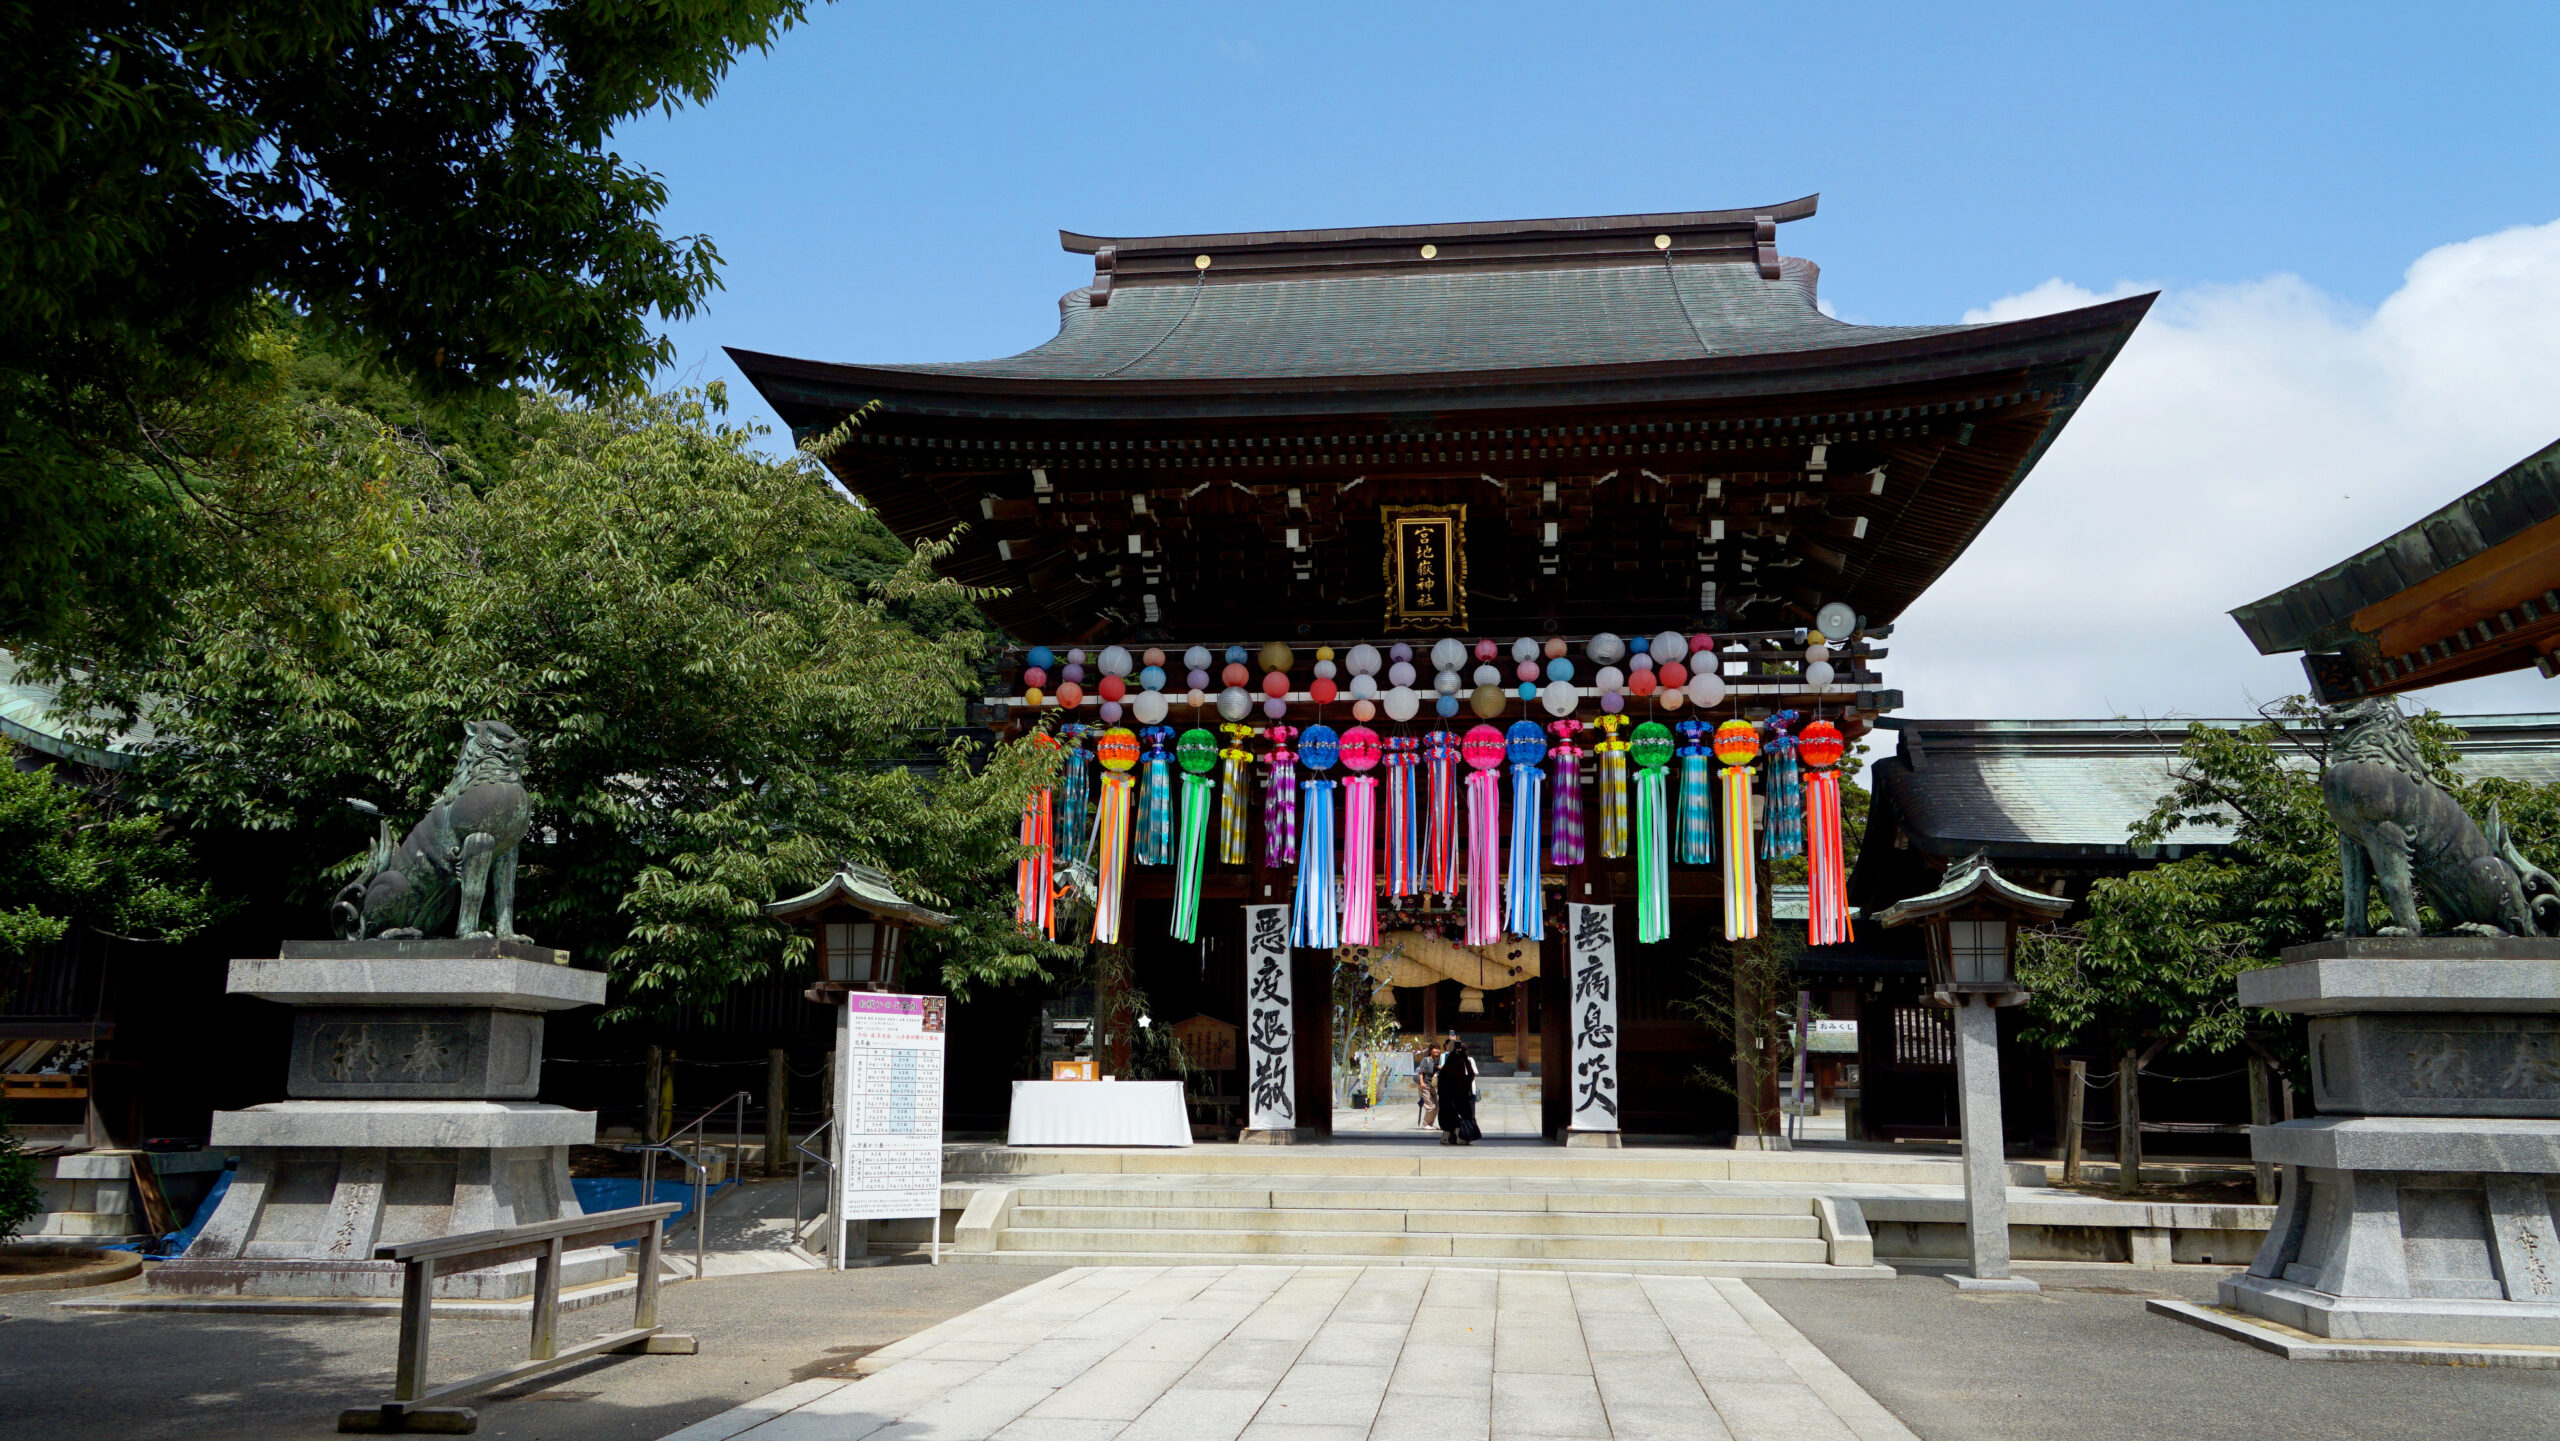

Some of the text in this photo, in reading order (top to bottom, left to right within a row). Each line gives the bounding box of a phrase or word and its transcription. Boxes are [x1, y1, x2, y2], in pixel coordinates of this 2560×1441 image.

[1414, 526, 1435, 607] 宮地嶽神社
[1250, 908, 1293, 1120] 悪疫退散
[1574, 906, 1616, 1118] 無病息災
[1819, 1022, 1854, 1031] おみくじ
